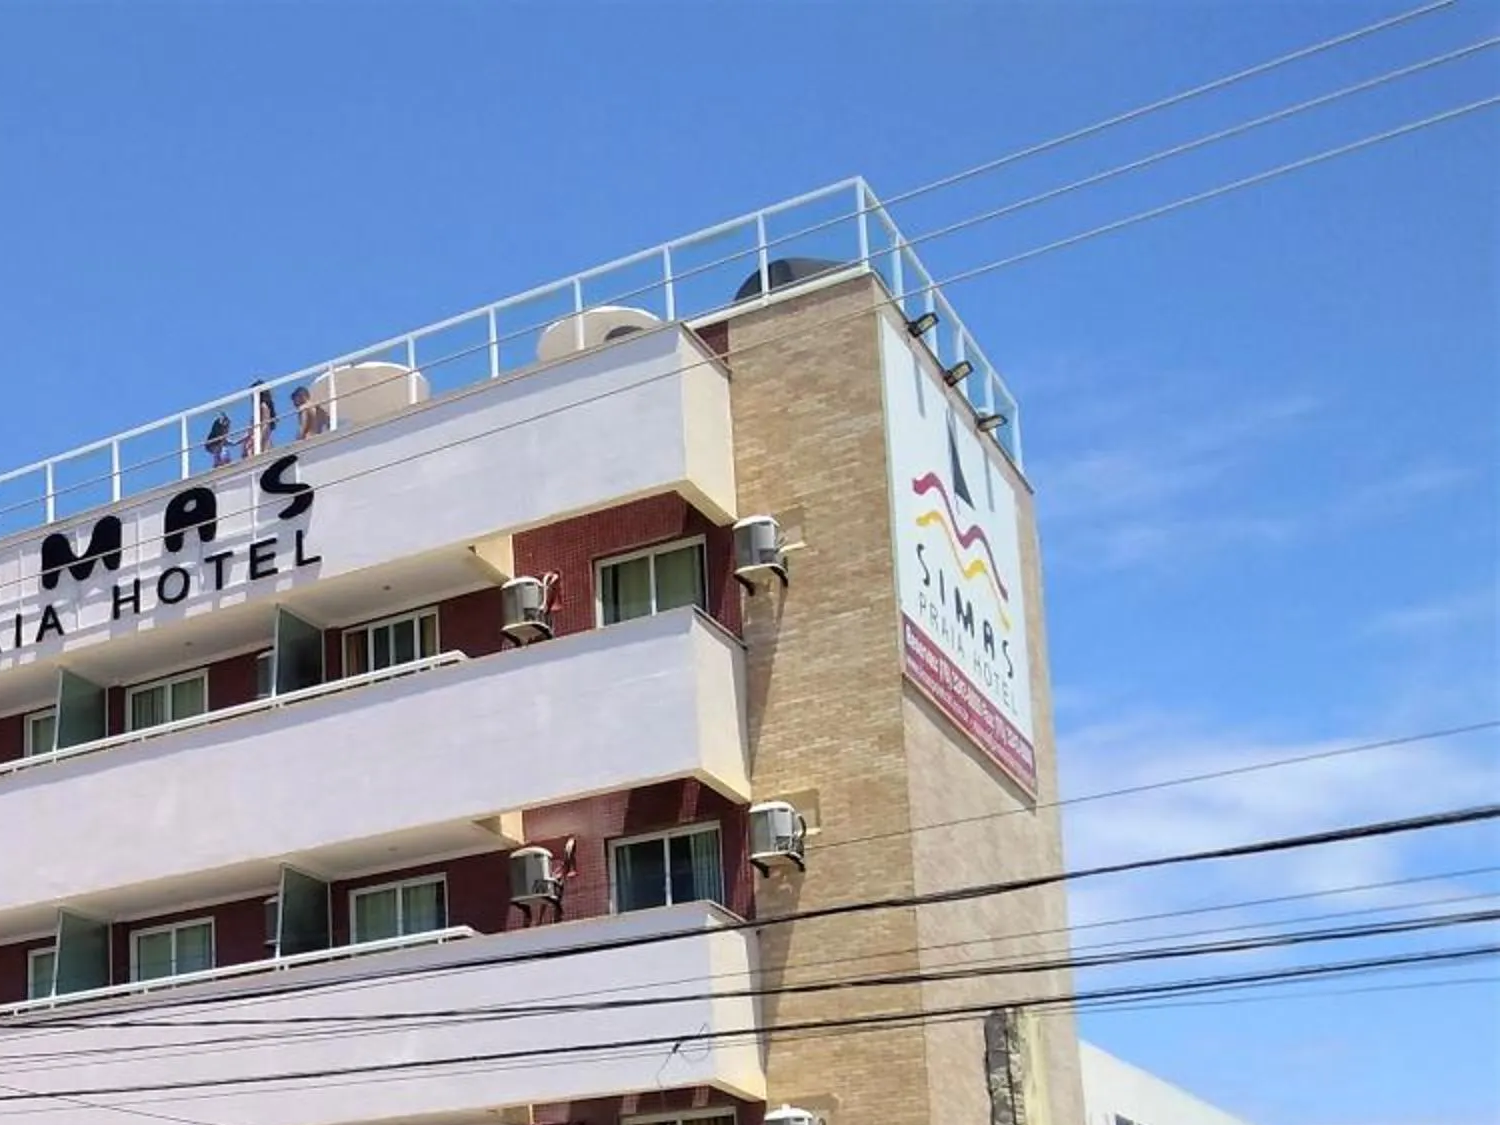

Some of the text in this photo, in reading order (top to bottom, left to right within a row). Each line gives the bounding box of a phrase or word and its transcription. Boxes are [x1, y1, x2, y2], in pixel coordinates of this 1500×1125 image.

[112, 530, 323, 622] HOTEL
[916, 543, 1014, 680] SIMAS
[918, 590, 1018, 716] PRAIA HOTEL
